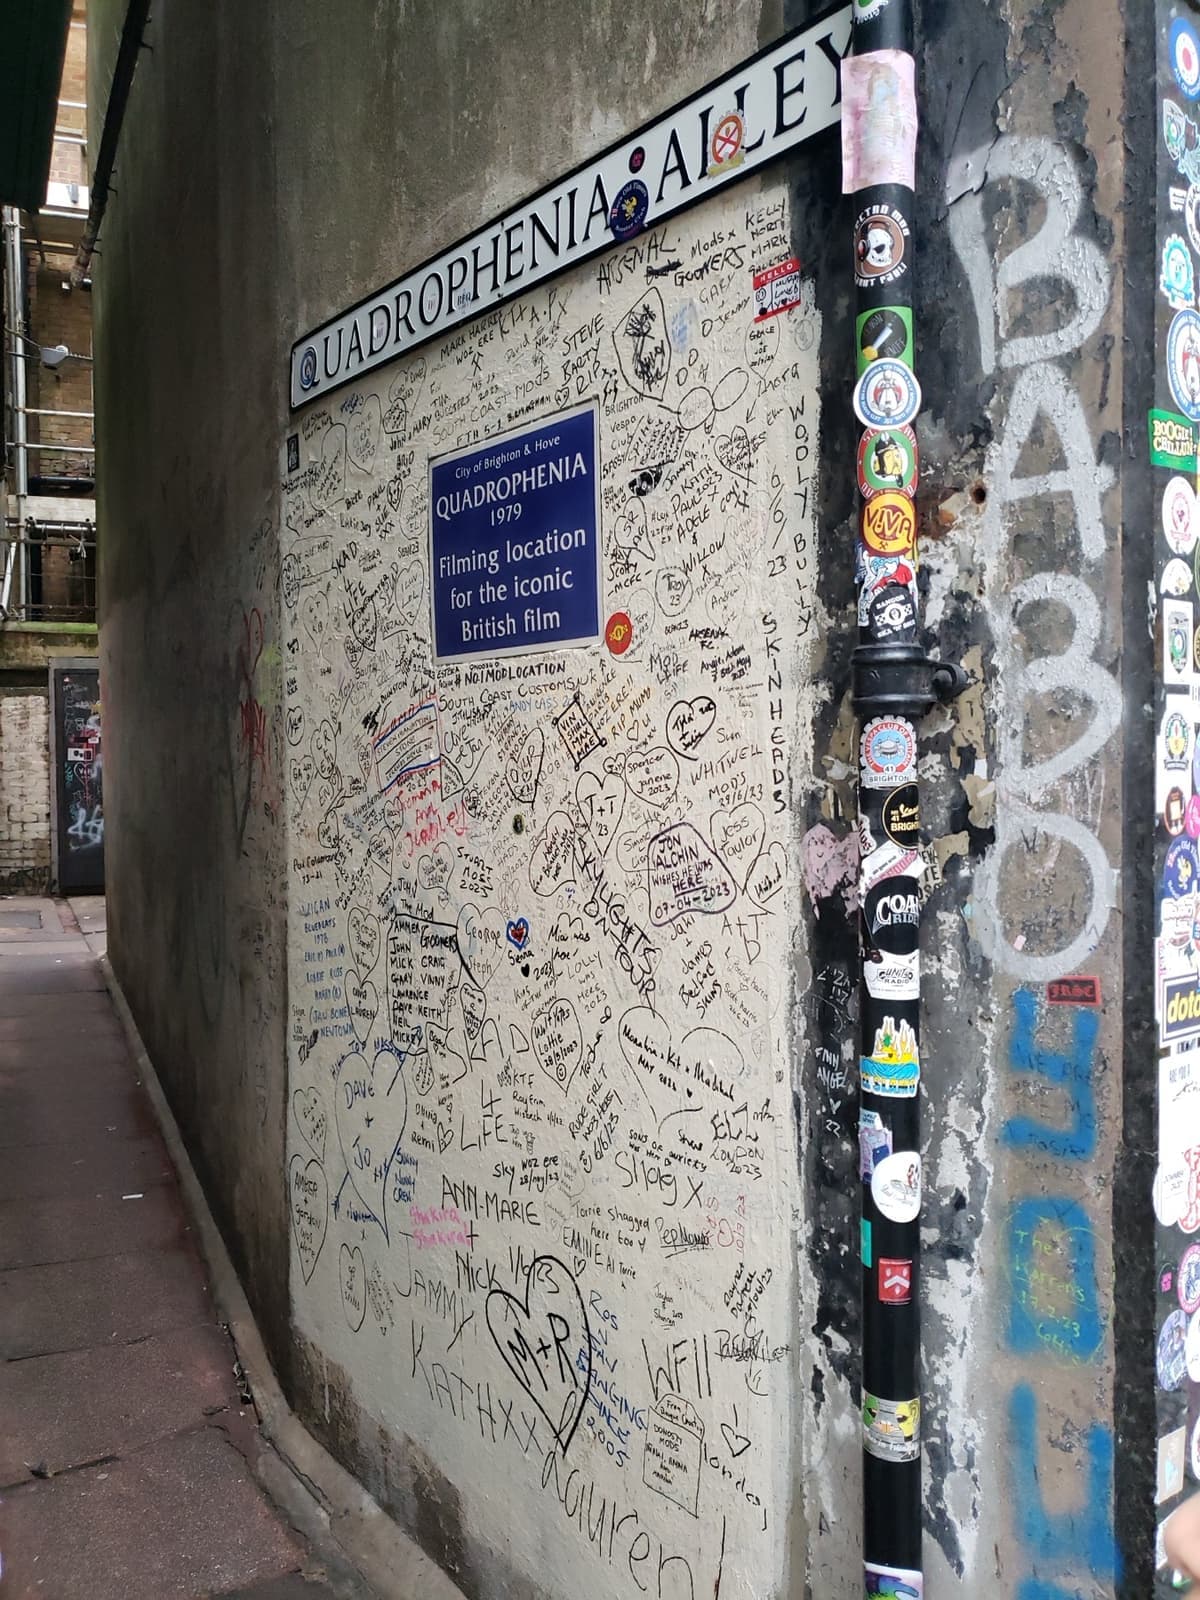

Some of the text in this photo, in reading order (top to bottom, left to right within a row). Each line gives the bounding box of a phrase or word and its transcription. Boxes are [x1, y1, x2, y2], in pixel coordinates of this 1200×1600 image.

[299, 20, 853, 388] QUADROPHENIA ALLEY
[746, 198, 785, 230] KELLY
[760, 263, 793, 282] HELLO
[562, 313, 604, 356] STEVE
[455, 435, 561, 480] City of Brighton & Hove
[436, 452, 588, 521] QUADROPHENIA
[490, 502, 522, 526] 1979
[439, 528, 586, 580] Filming location
[450, 568, 573, 610] for the iconic
[462, 607, 561, 642] British film
[480, 688, 512, 706] COAST
[571, 728, 591, 749] MAX
[869, 775, 909, 783] BRIGHTON
[885, 765, 894, 773] 41
[654, 842, 699, 870] ALCHIN
[659, 833, 681, 854] JON
[457, 846, 493, 875] STUART
[390, 956, 447, 969] MICK CRAIG
